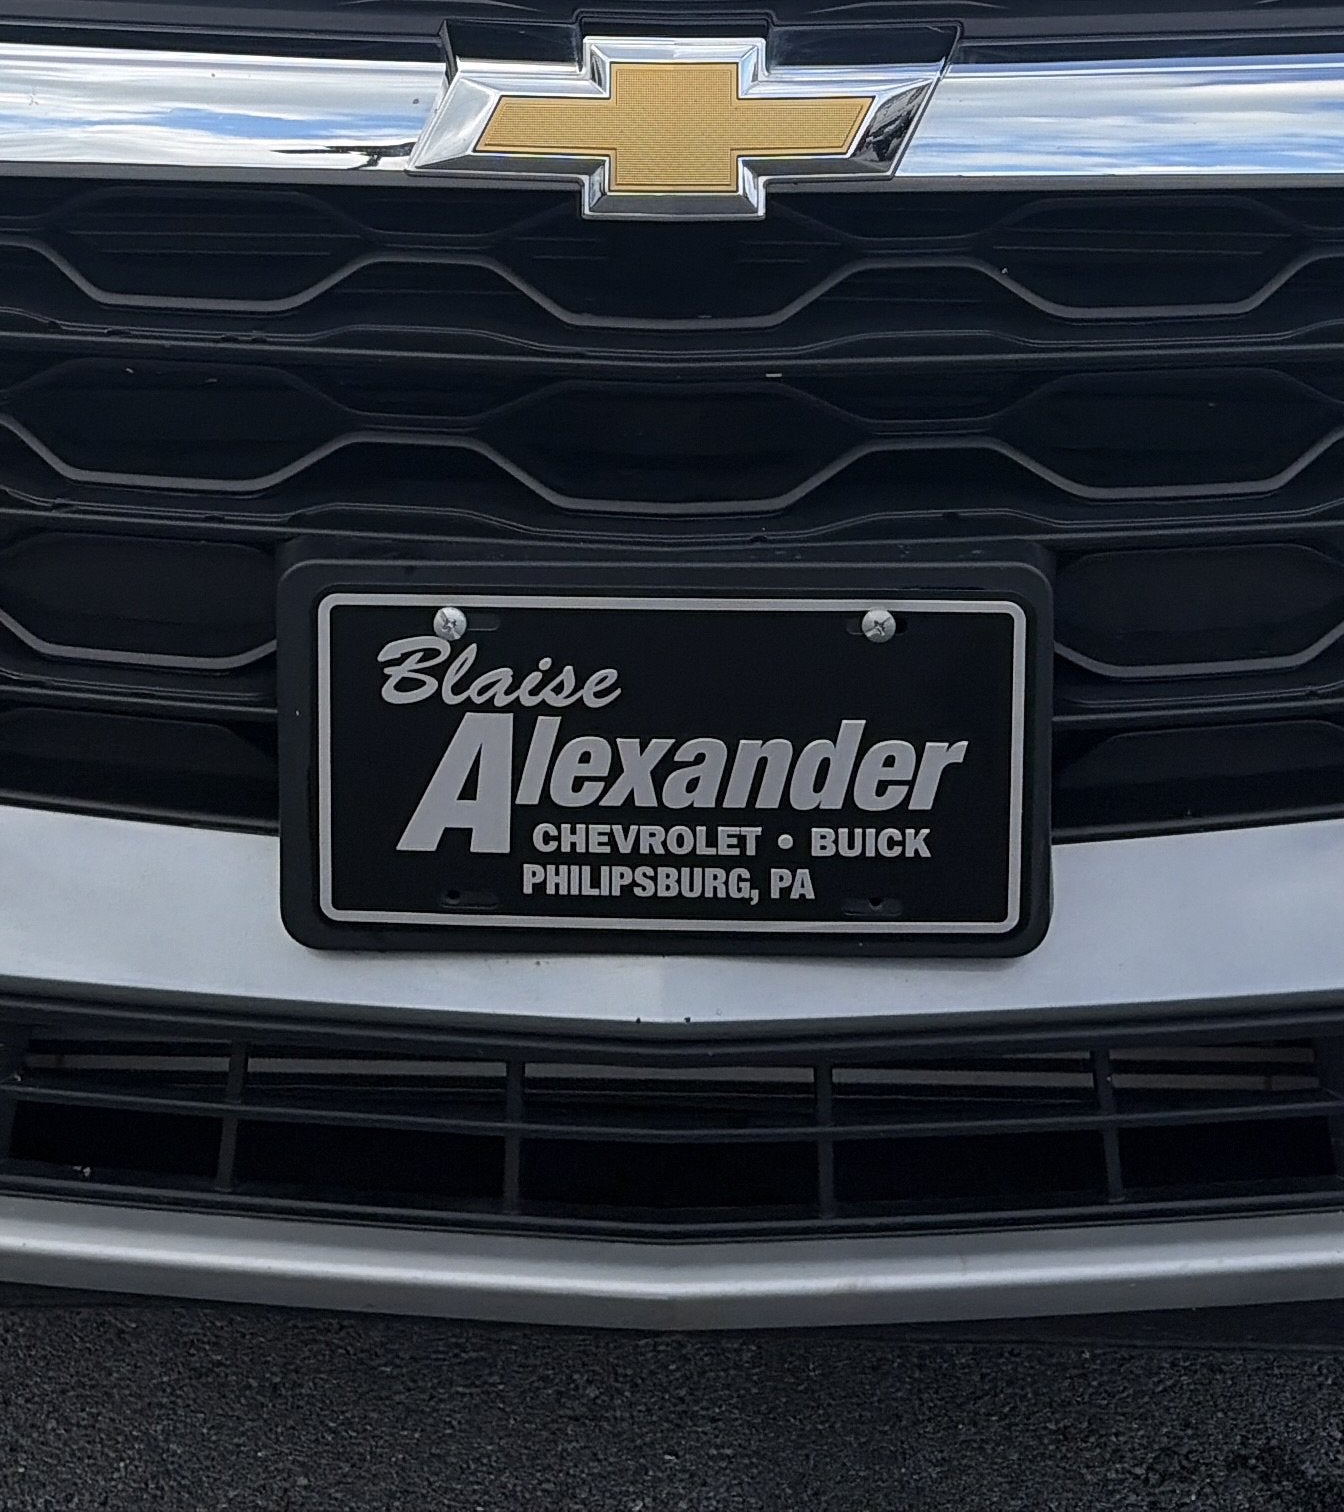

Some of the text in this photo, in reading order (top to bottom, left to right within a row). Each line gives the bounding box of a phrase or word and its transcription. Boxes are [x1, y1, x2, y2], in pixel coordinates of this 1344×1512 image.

[376, 635, 623, 709] Blaise
[395, 711, 969, 855] Alexander
[532, 822, 932, 859] CHEVROLET BUICK
[521, 864, 816, 905] PHILIPSBURG, PA
